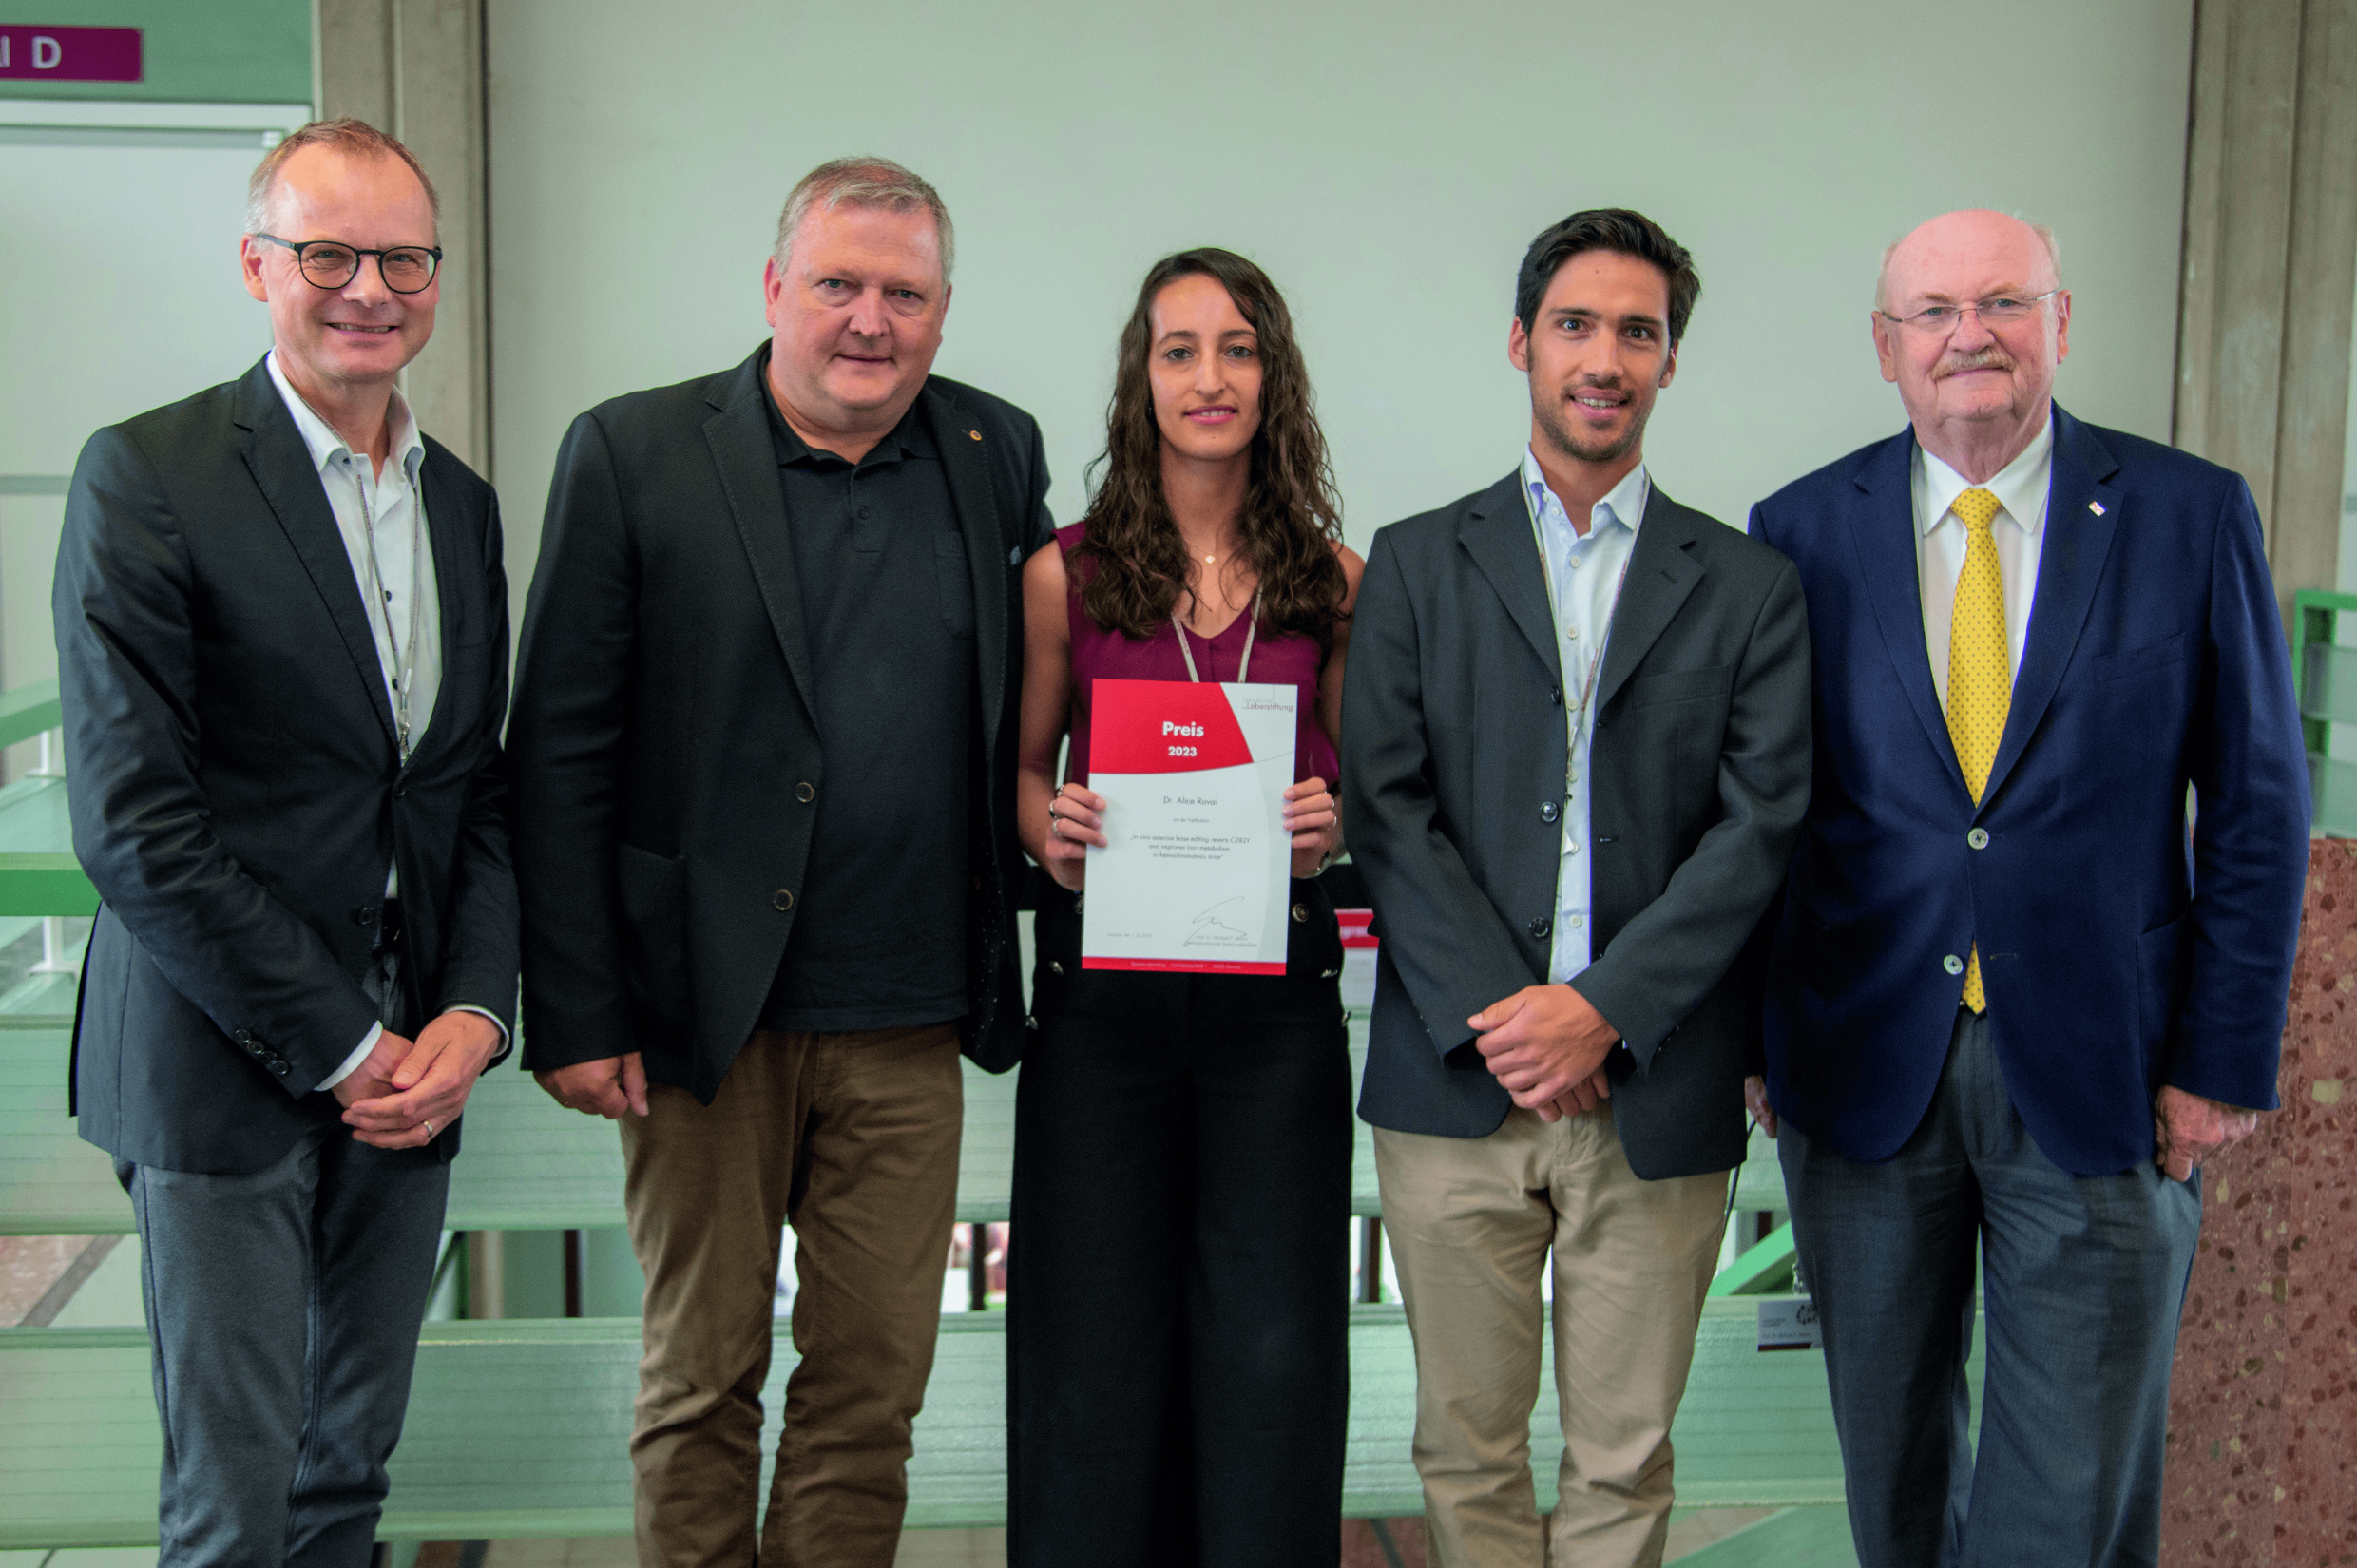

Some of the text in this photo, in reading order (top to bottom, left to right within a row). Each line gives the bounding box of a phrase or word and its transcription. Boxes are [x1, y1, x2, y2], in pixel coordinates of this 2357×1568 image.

[1246, 702, 1293, 713] Leberstiftung
[1162, 720, 1204, 737] Preis
[1168, 745, 1198, 757] 2023
[1163, 795, 1217, 806] Dr. Alice Rovai
[1190, 835, 1210, 844] editing
